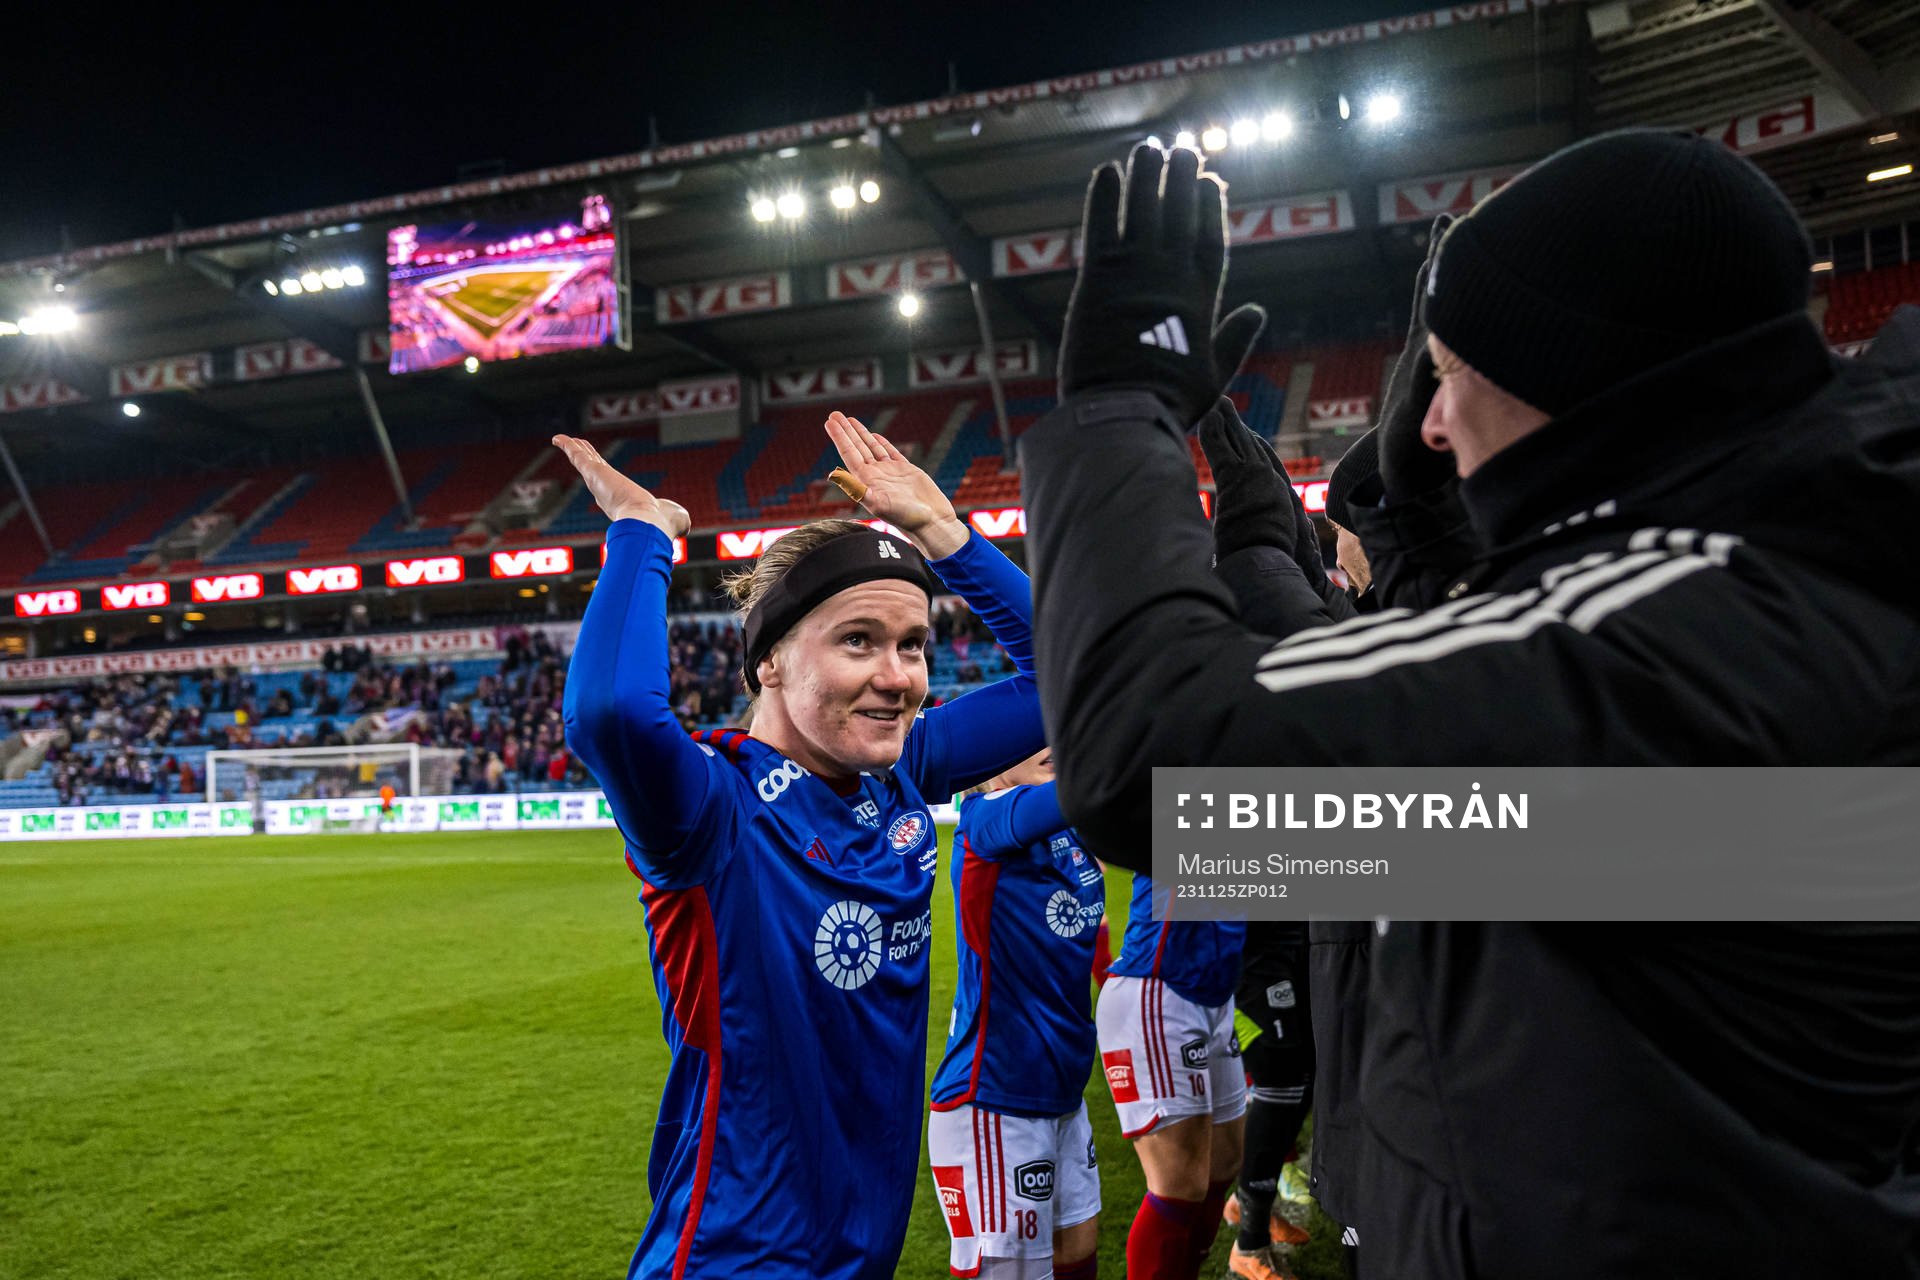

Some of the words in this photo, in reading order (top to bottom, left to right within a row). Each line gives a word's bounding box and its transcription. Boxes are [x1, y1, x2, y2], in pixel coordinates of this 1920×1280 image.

[1010, 236, 1082, 270] V
[838, 254, 954, 295] VG
[669, 276, 777, 319] VG
[921, 351, 1027, 380] VG
[771, 370, 872, 397] VG
[663, 384, 736, 411] VG
[1310, 401, 1369, 418] VG
[971, 510, 1026, 536] V
[389, 558, 462, 585] VG
[494, 548, 570, 576] VG
[194, 575, 260, 600] VG
[290, 567, 359, 594] VG
[17, 592, 77, 616] VG
[104, 583, 168, 609] VG
[889, 944, 908, 961] FOR
[1274, 1019, 1283, 1038] 1
[1188, 1073, 1206, 1096] 10
[1024, 1172, 1053, 1188] oon
[943, 1192, 959, 1205] ON
[947, 1207, 961, 1217] ELS
[1015, 1210, 1038, 1240] 18
